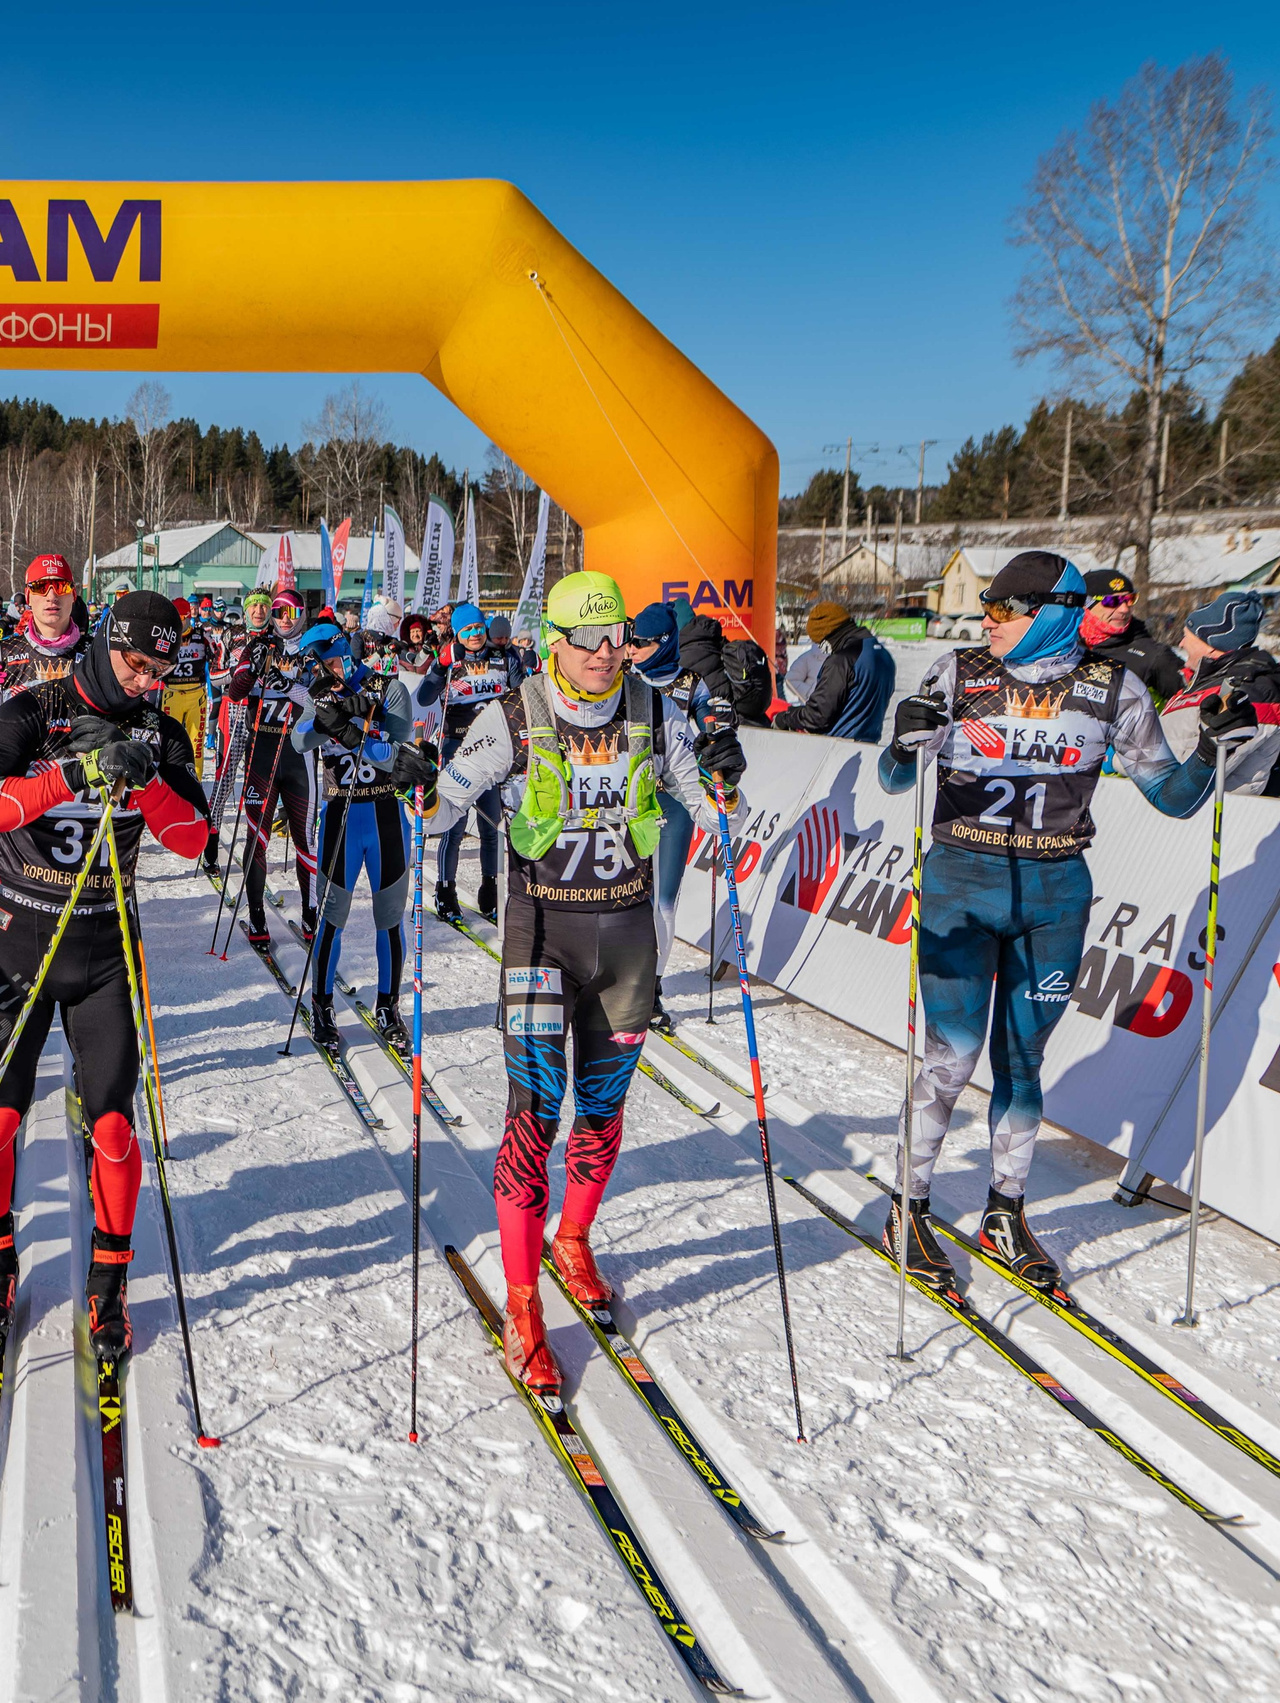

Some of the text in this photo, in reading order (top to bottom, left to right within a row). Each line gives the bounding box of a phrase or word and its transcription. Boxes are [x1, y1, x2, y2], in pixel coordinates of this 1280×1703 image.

[42, 557, 63, 568] DNB
[662, 579, 753, 608] БАМ
[151, 625, 177, 644] DNB
[7, 652, 29, 663] БАМ
[173, 663, 193, 677] 43
[475, 685, 502, 693] LAND
[965, 676, 1000, 688] БАМ
[263, 701, 293, 726] 74
[195, 707, 206, 758] unicars
[1013, 728, 1086, 748] KRAS
[1011, 741, 1082, 766] LAND
[340, 755, 376, 785] 28
[579, 777, 628, 790] KRA
[580, 791, 626, 809] LAN
[979, 778, 1048, 830] 21
[745, 808, 780, 841] AS
[951, 823, 1076, 849] КОРОЛЕВСКИЕ КРАСКИ
[51, 819, 109, 867] 31
[555, 832, 623, 881] 75
[853, 838, 915, 884] KRA
[526, 878, 644, 901] КОРОЛЕВСКИЕ КРАСКИ
[825, 872, 918, 945] LAND
[1091, 896, 1226, 971] RAS
[1024, 990, 1071, 1002] Löffler
[1071, 945, 1193, 1038] AND
[524, 1022, 562, 1032] GAZPROM
[910, 1278, 953, 1314] FISCHER
[1011, 1276, 1061, 1314] FISCHER
[661, 1415, 722, 1487] FISCHER
[107, 1513, 126, 1594] FISCHER
[610, 1528, 675, 1620] FISCHER
